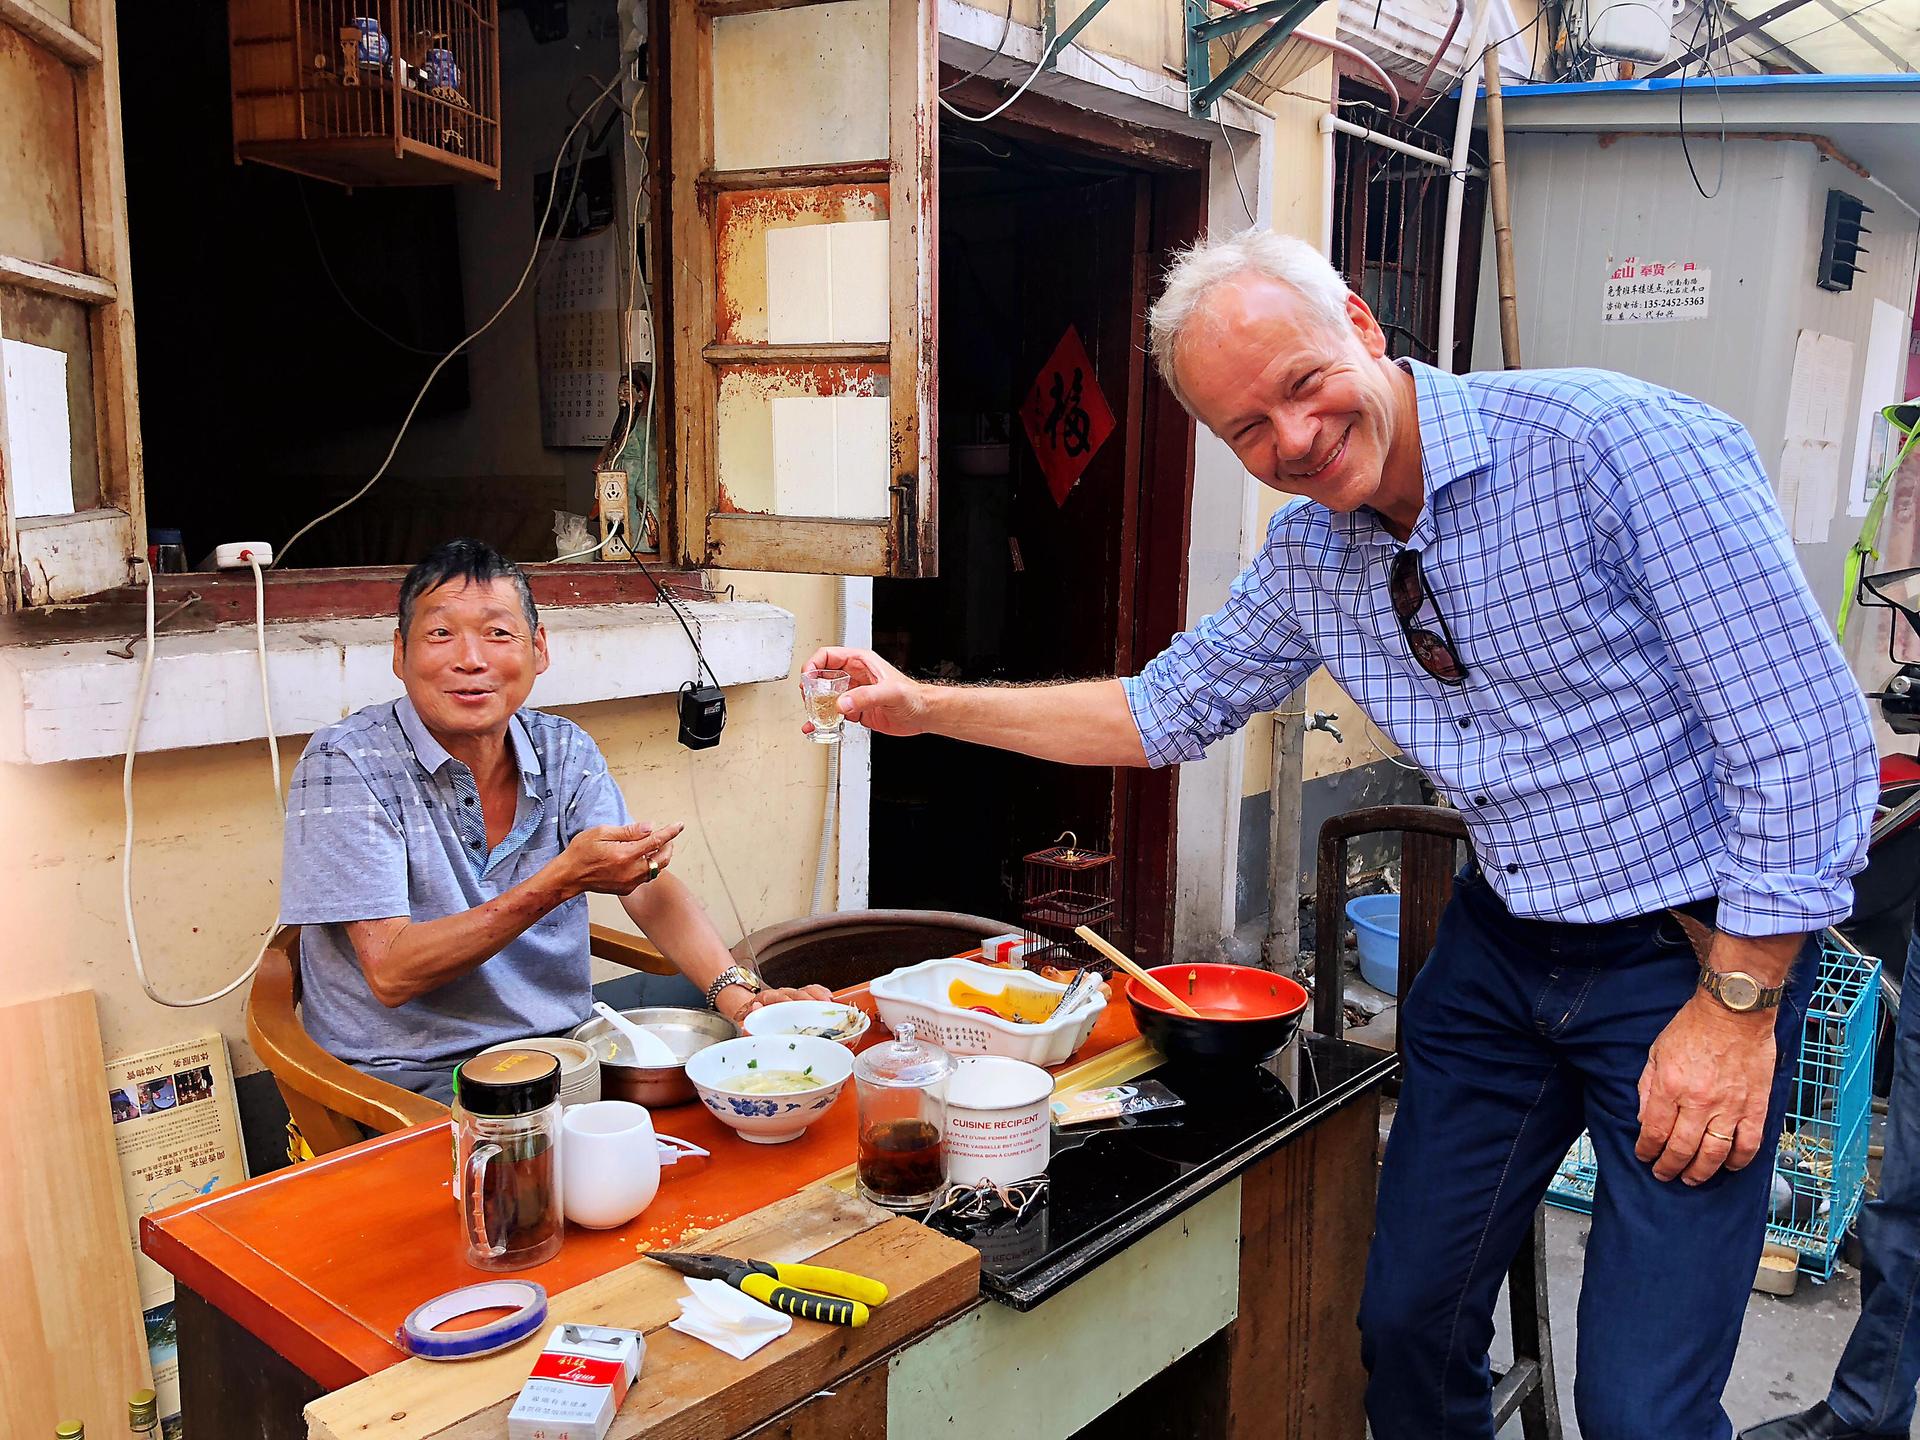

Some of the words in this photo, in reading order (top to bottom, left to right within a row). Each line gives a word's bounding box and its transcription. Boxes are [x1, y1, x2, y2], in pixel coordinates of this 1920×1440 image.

[1640, 263, 1665, 277] 奉贤
[1643, 296, 1705, 309] 135-2452-5363
[1043, 367, 1091, 458] 福
[952, 1118, 991, 1130] CUISINE
[994, 1113, 1039, 1129] RÉCIPENT
